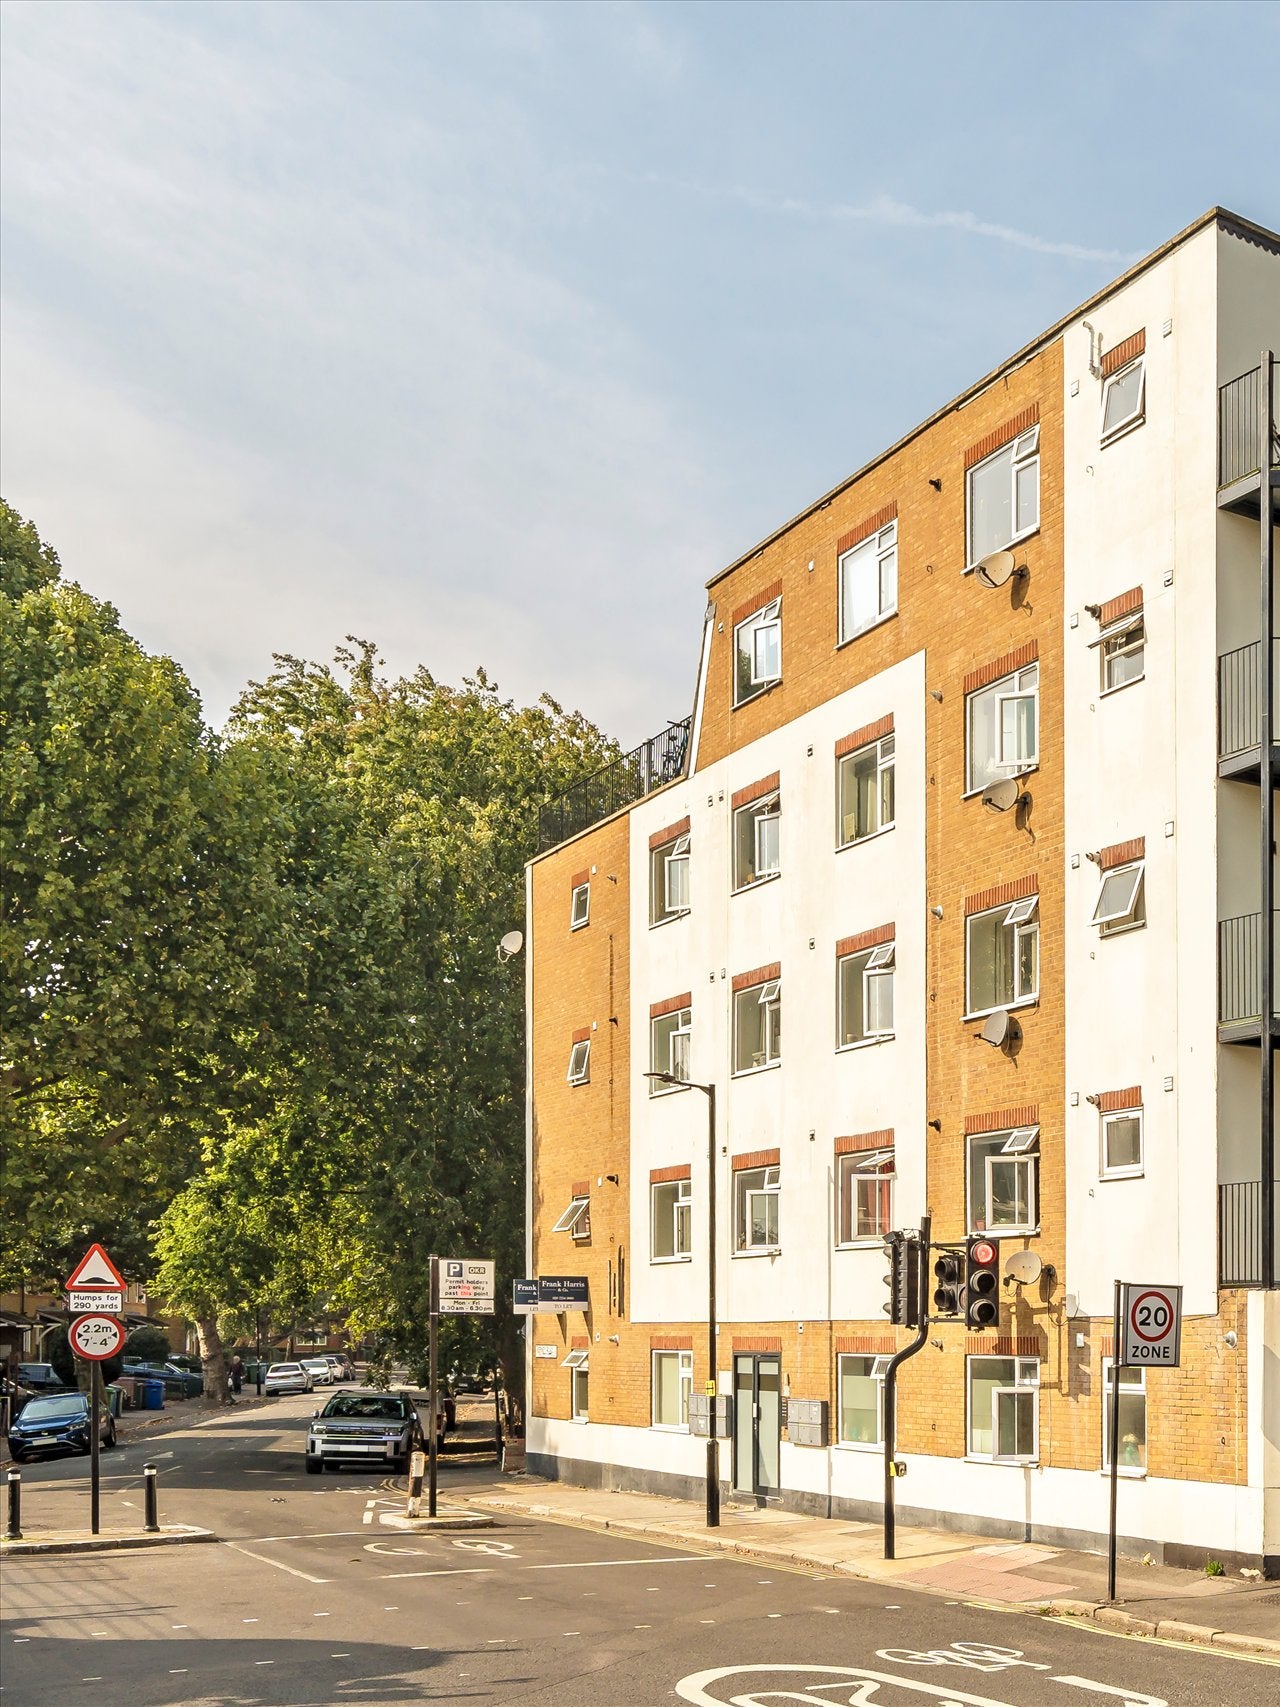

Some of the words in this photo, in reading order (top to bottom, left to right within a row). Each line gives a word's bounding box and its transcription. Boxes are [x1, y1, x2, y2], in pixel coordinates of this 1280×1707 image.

[450, 1263, 460, 1276] P
[469, 1267, 486, 1275] OKR
[95, 1302, 118, 1310] yards
[1139, 1306, 1167, 1327] 20
[82, 1324, 112, 1333] 2.2m
[1132, 1345, 1170, 1358] ZONE
